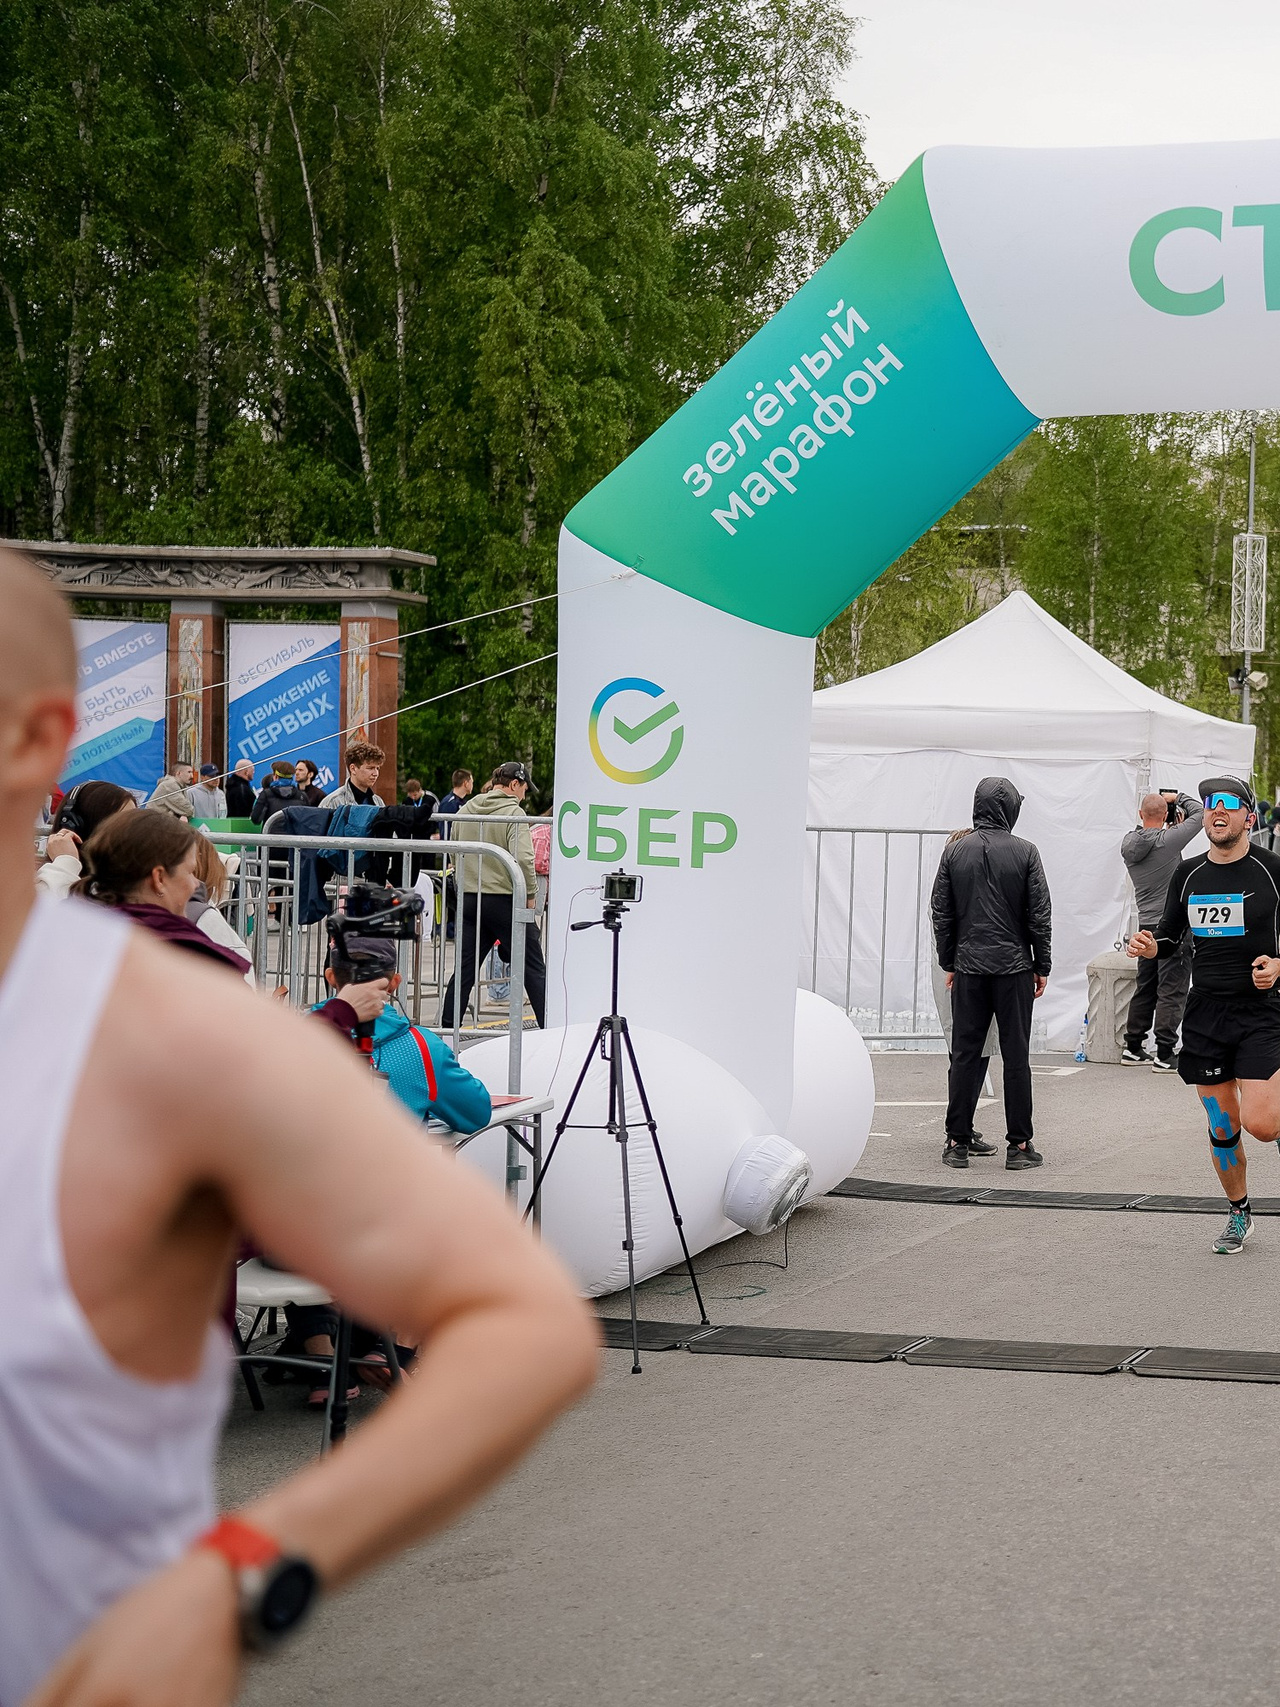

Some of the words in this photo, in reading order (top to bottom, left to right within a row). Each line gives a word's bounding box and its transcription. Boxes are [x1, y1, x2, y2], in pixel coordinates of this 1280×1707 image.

[682, 299, 871, 498] зелёный
[710, 343, 904, 536] марафон
[93, 632, 156, 670] ВМЕСТЕ
[237, 637, 315, 685] ФЕСТИВАЛЬ
[84, 685, 127, 711] БЫТЬ
[84, 683, 154, 727] РОССИЕЙ
[242, 668, 331, 732] ДВИЖЕНИЕ
[81, 725, 145, 761] ПОЛЕЗНЫМ
[237, 692, 335, 759] ПЕРВЫХ
[557, 800, 738, 869] СБЕР
[1197, 906, 1232, 924] 729
